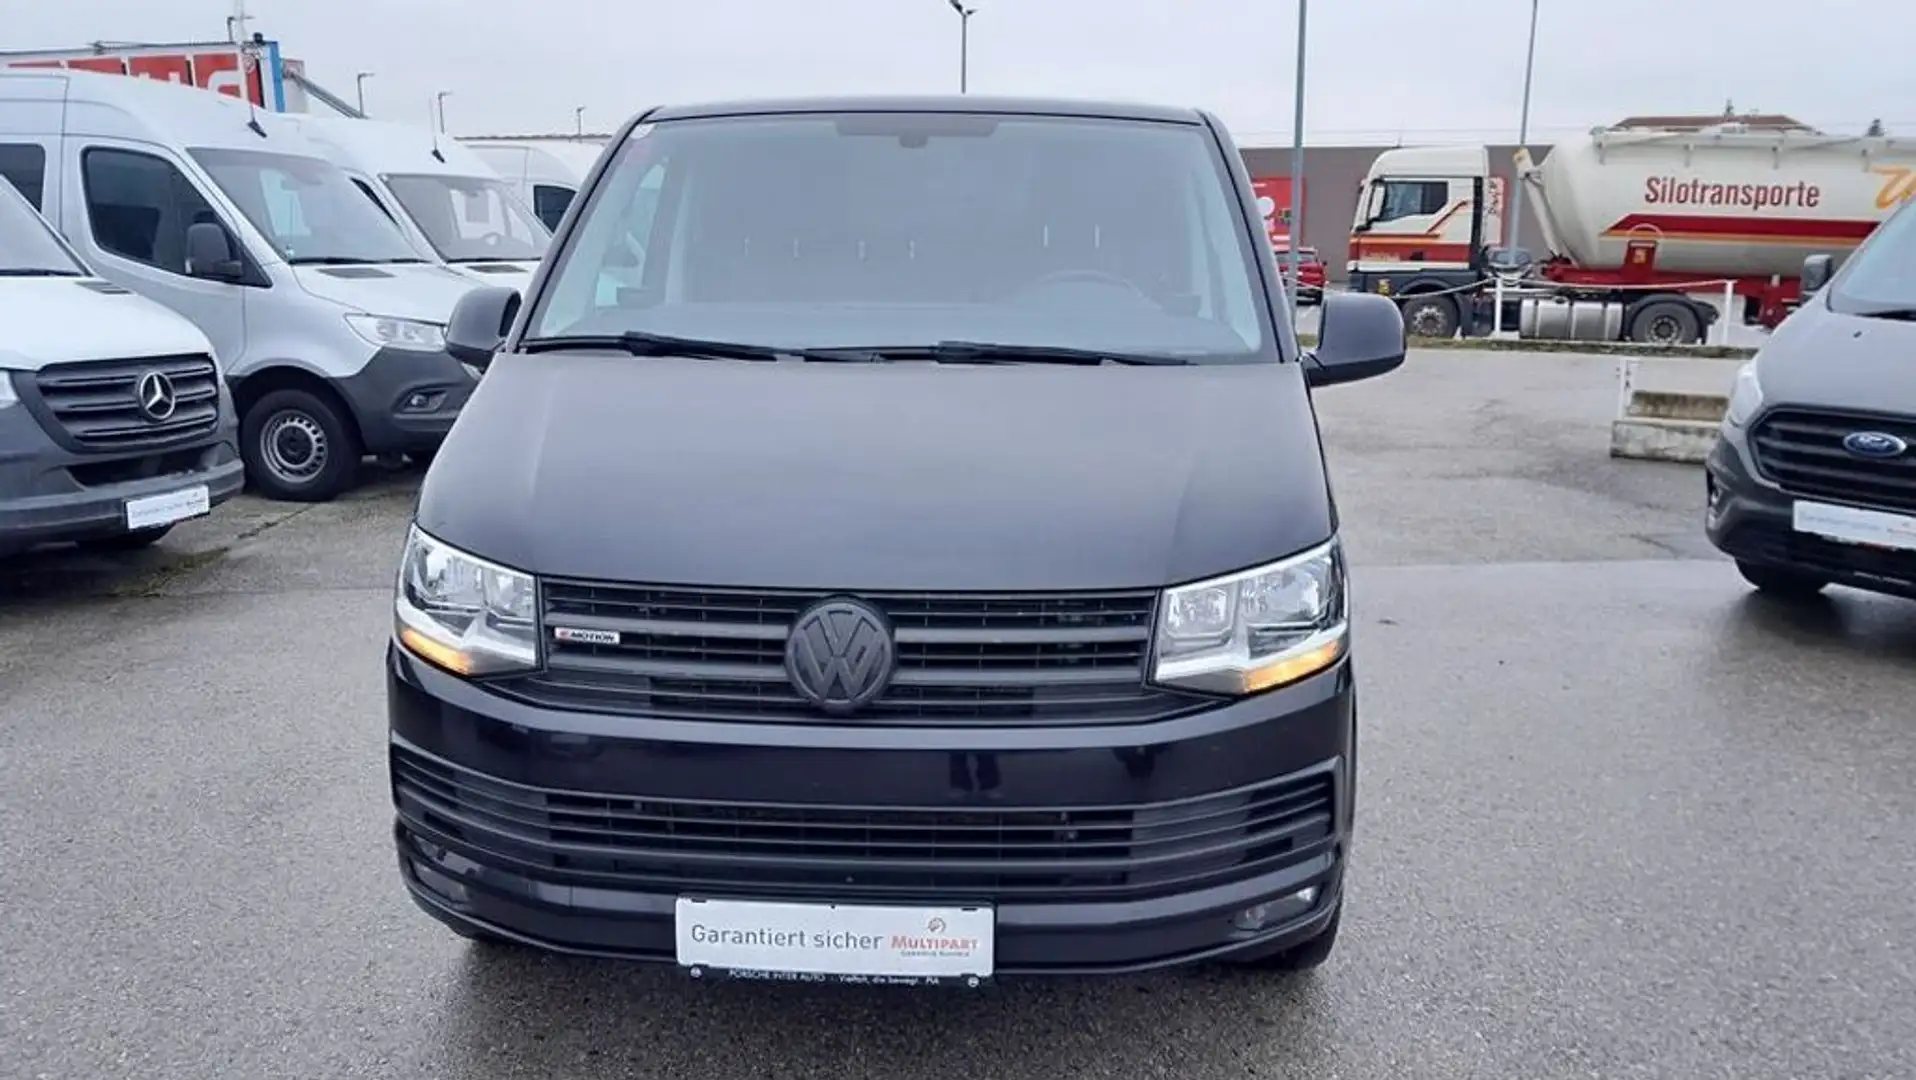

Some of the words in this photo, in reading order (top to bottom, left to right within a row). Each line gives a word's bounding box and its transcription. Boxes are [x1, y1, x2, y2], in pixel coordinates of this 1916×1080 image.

[1644, 177, 1820, 211] Silotransporte
[691, 924, 806, 948] Garantiert
[812, 930, 884, 950] sicher
